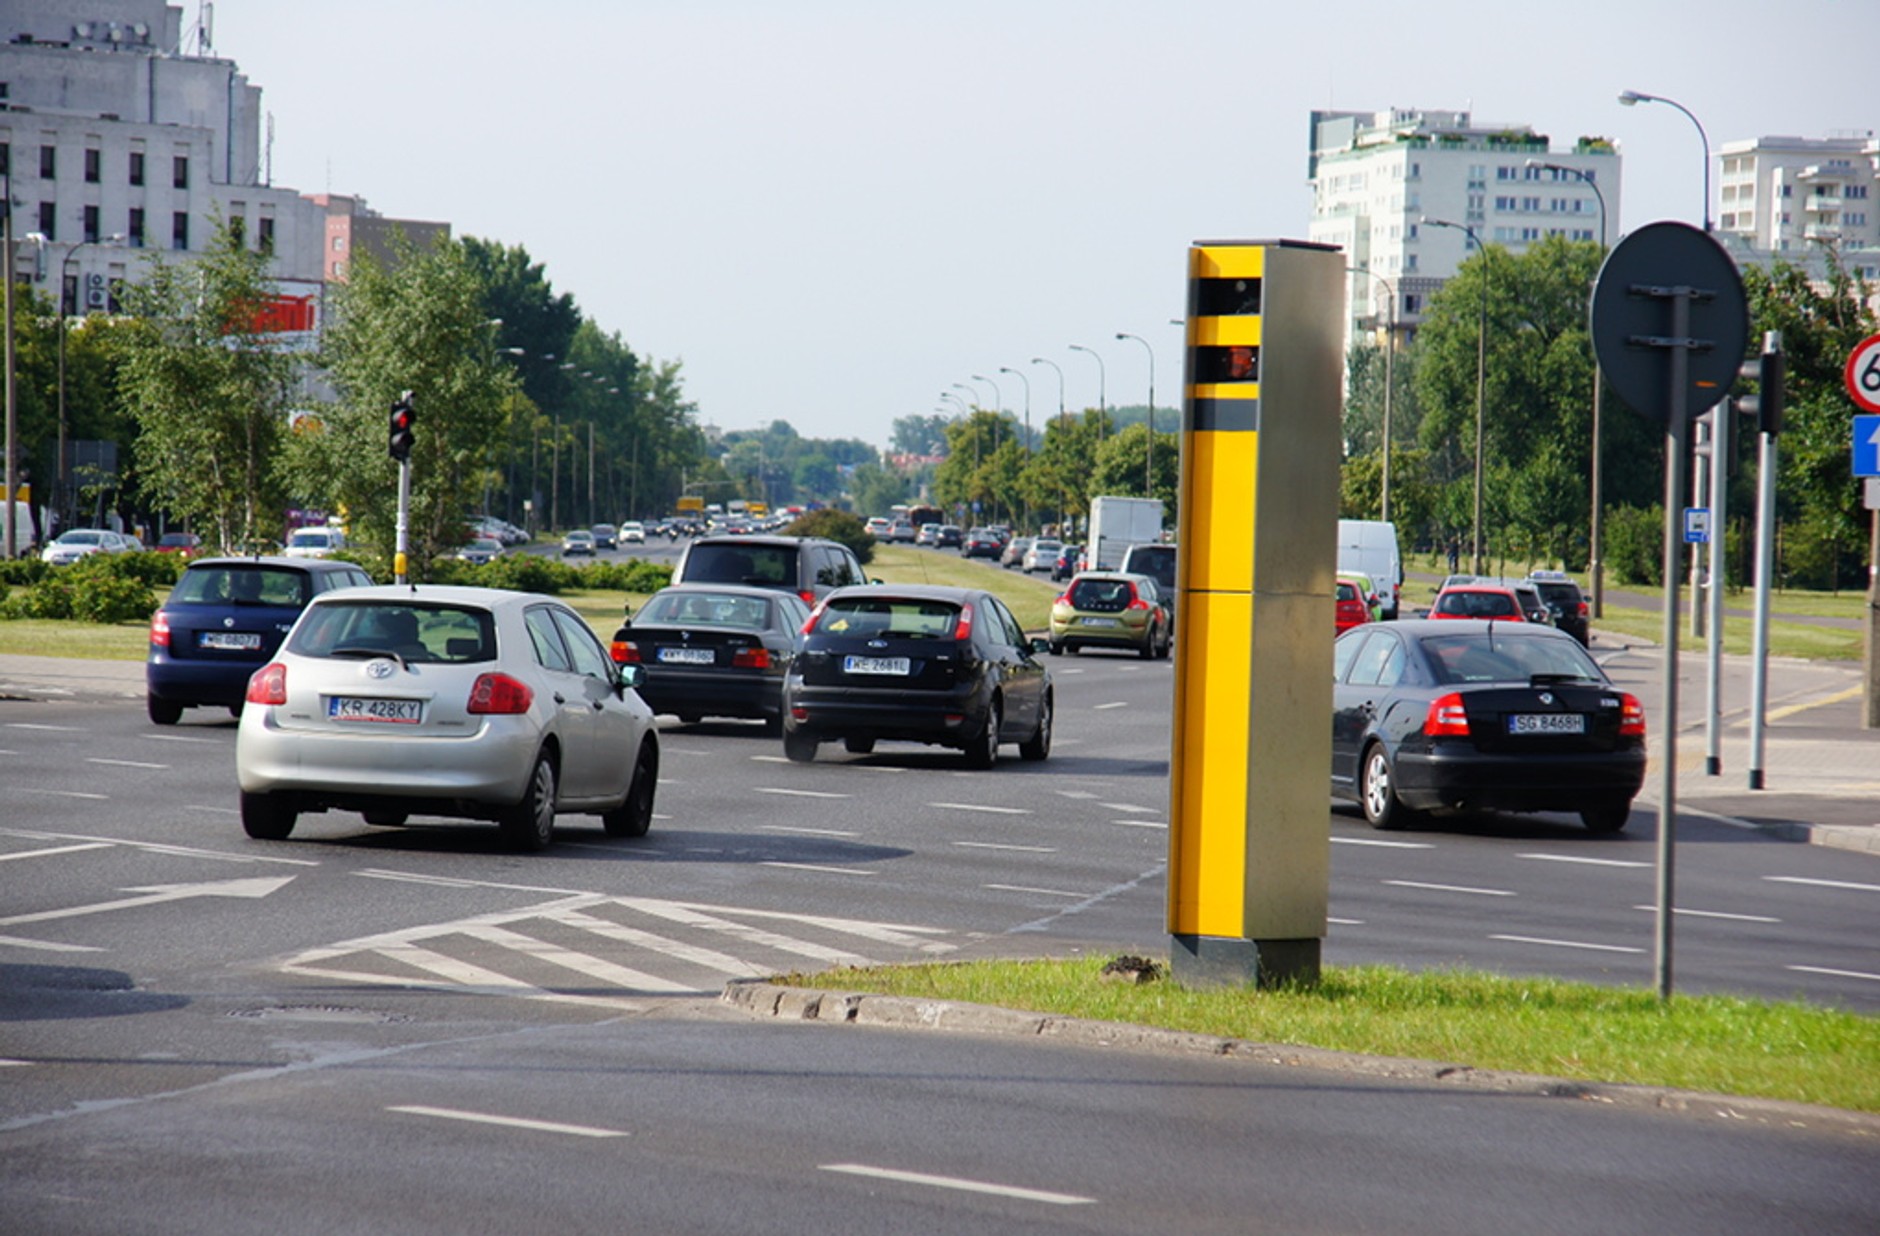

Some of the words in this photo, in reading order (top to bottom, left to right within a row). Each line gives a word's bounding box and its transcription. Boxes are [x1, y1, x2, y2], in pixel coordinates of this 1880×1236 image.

[340, 699, 363, 715] KR
[369, 701, 418, 718] 428KY
[1517, 716, 1537, 730] SG
[1541, 716, 1581, 730] 8468H
